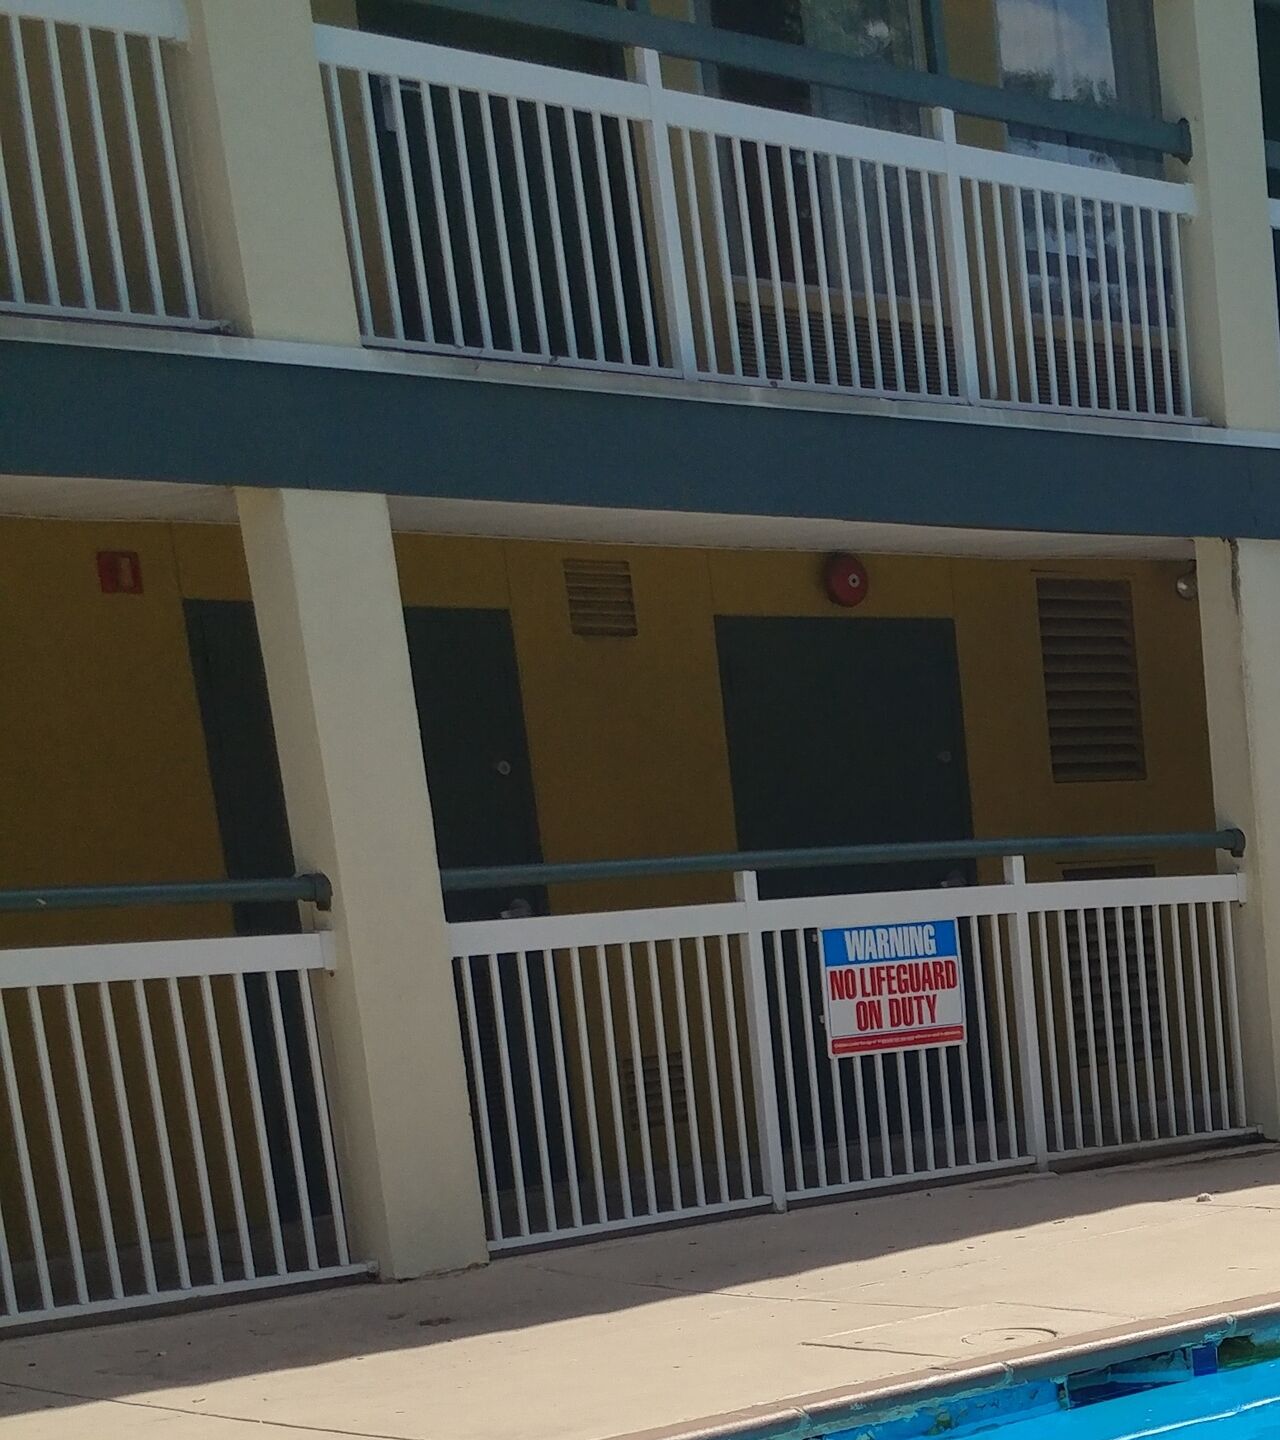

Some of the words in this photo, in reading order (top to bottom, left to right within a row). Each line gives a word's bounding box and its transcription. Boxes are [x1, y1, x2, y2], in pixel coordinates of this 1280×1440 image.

[845, 925, 936, 961] WARNING
[829, 968, 857, 1000] NO
[860, 960, 957, 997] LIFEGUARD
[855, 1000, 883, 1032] ON
[889, 994, 937, 1027] DUTY
